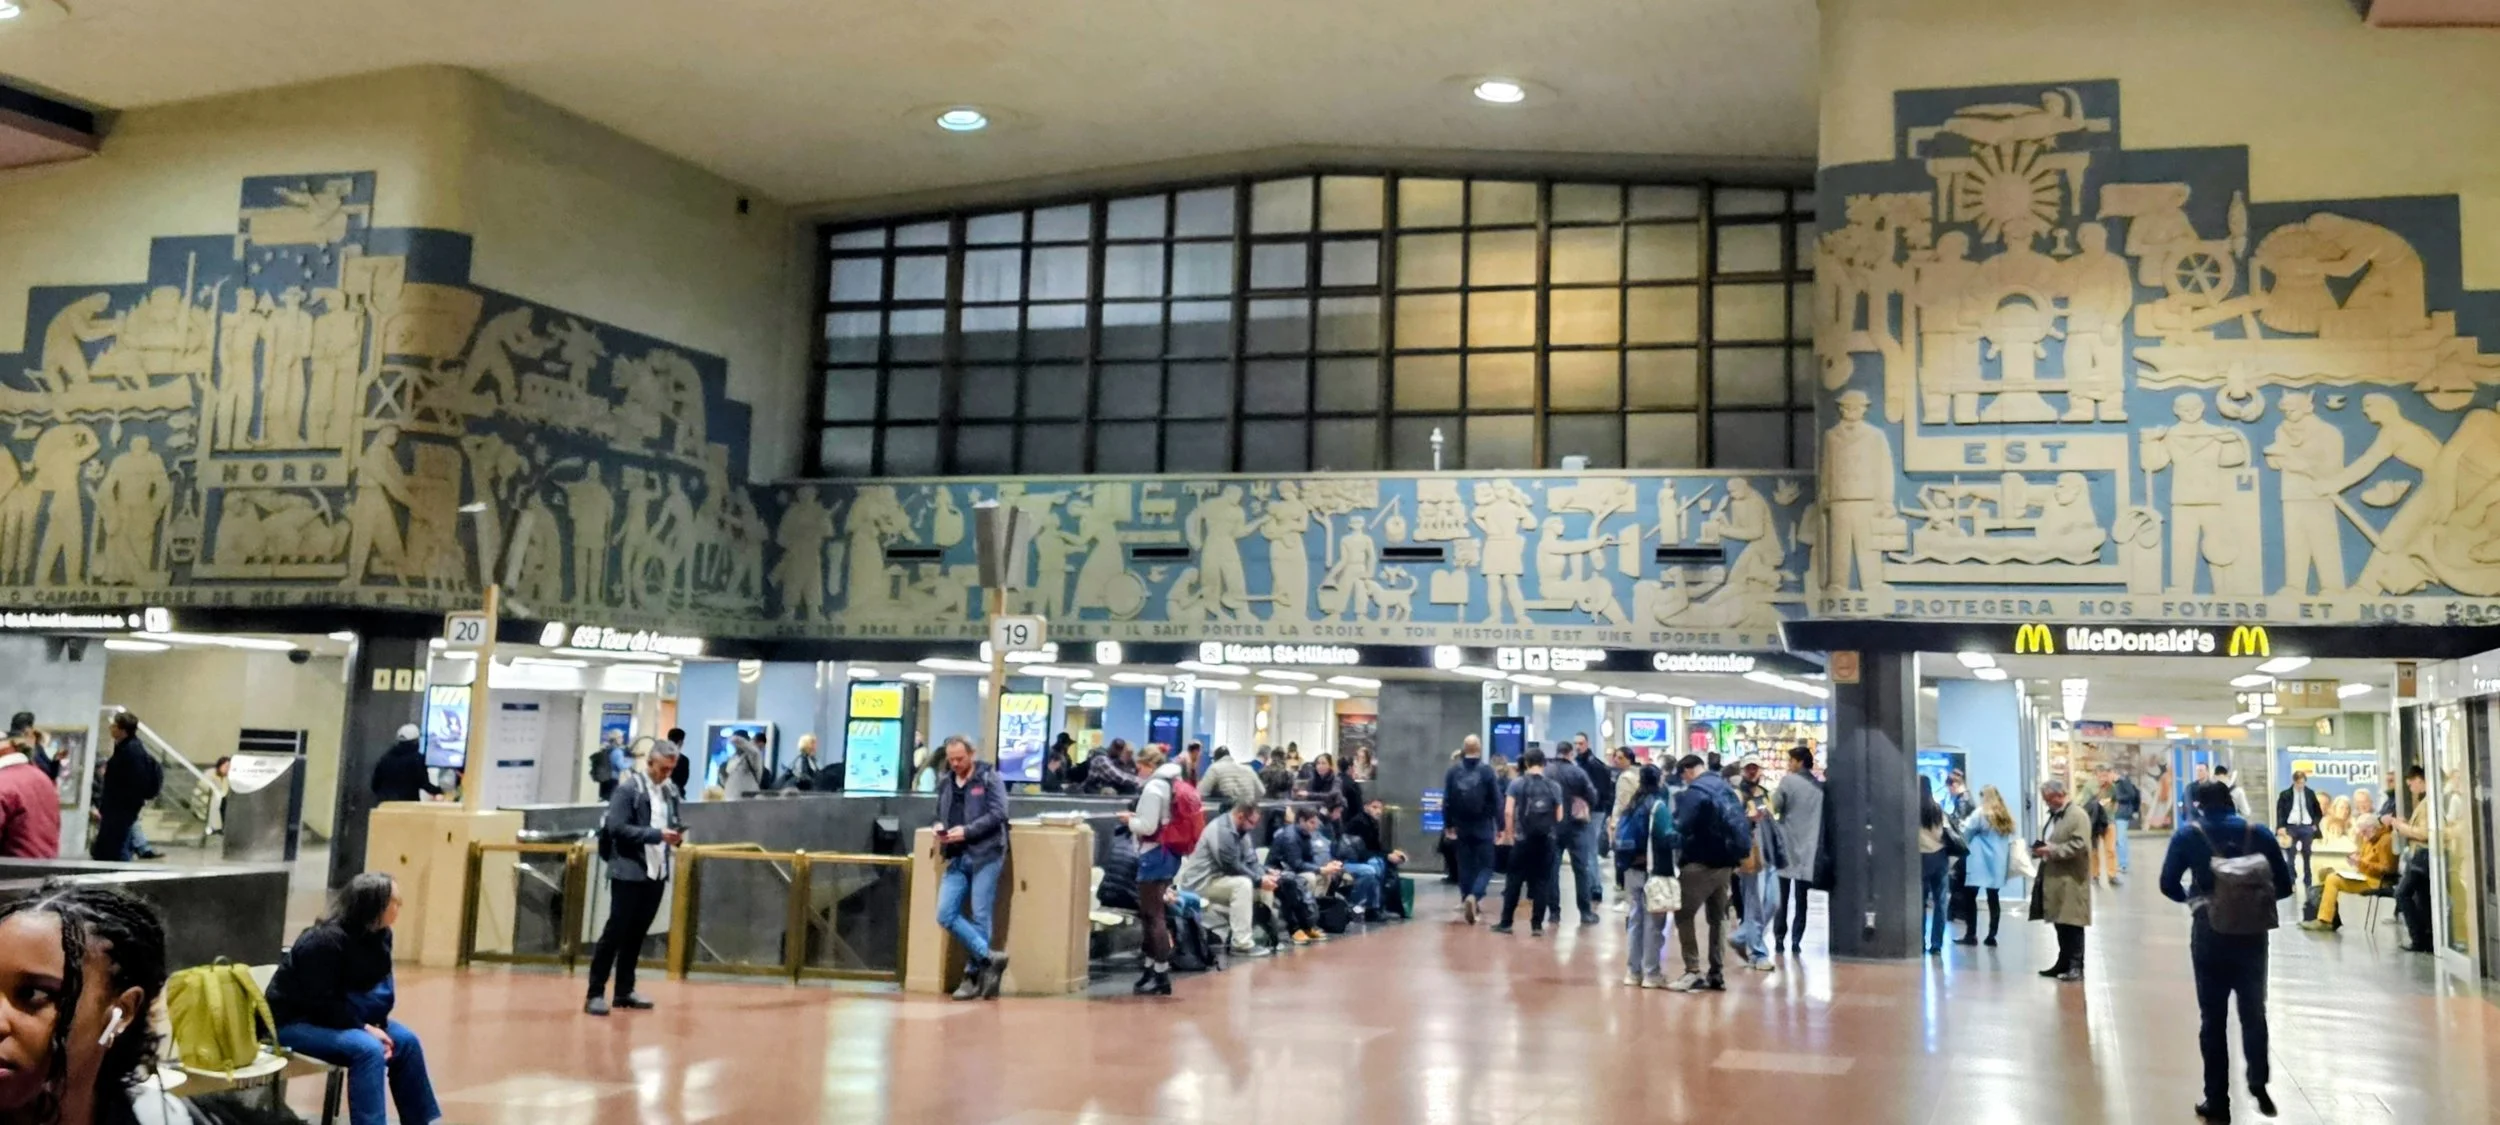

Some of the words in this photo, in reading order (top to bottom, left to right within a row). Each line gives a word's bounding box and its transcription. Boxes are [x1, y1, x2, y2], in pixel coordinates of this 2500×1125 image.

[1963, 441, 2067, 464] EST
[222, 462, 327, 482] NORD
[35, 589, 100, 602] CANADA
[1895, 599, 2055, 616] PROTEGERA
[2079, 601, 2134, 616] NOS
[2162, 602, 2268, 618] FOYERS
[2300, 603, 2333, 618] ET
[2360, 604, 2416, 619] NOS
[455, 621, 479, 641] 20
[1003, 624, 1028, 645] 19
[1153, 624, 1188, 636] SAIT
[1202, 624, 1264, 637] PORTER
[1279, 625, 1299, 636] LA
[1314, 625, 1364, 637] CROIX
[1405, 626, 1436, 638] TON
[1453, 628, 1535, 640] HISTOIRE
[1551, 630, 1583, 641] EST
[1598, 631, 1632, 642] UNE
[1650, 632, 1721, 644] EPOPEE
[2066, 627, 2216, 653] McDonald's
[1225, 643, 1272, 662] Mont
[1653, 652, 1755, 672] Cordonnier
[1170, 680, 1186, 693] 22
[1489, 687, 1506, 698] 21
